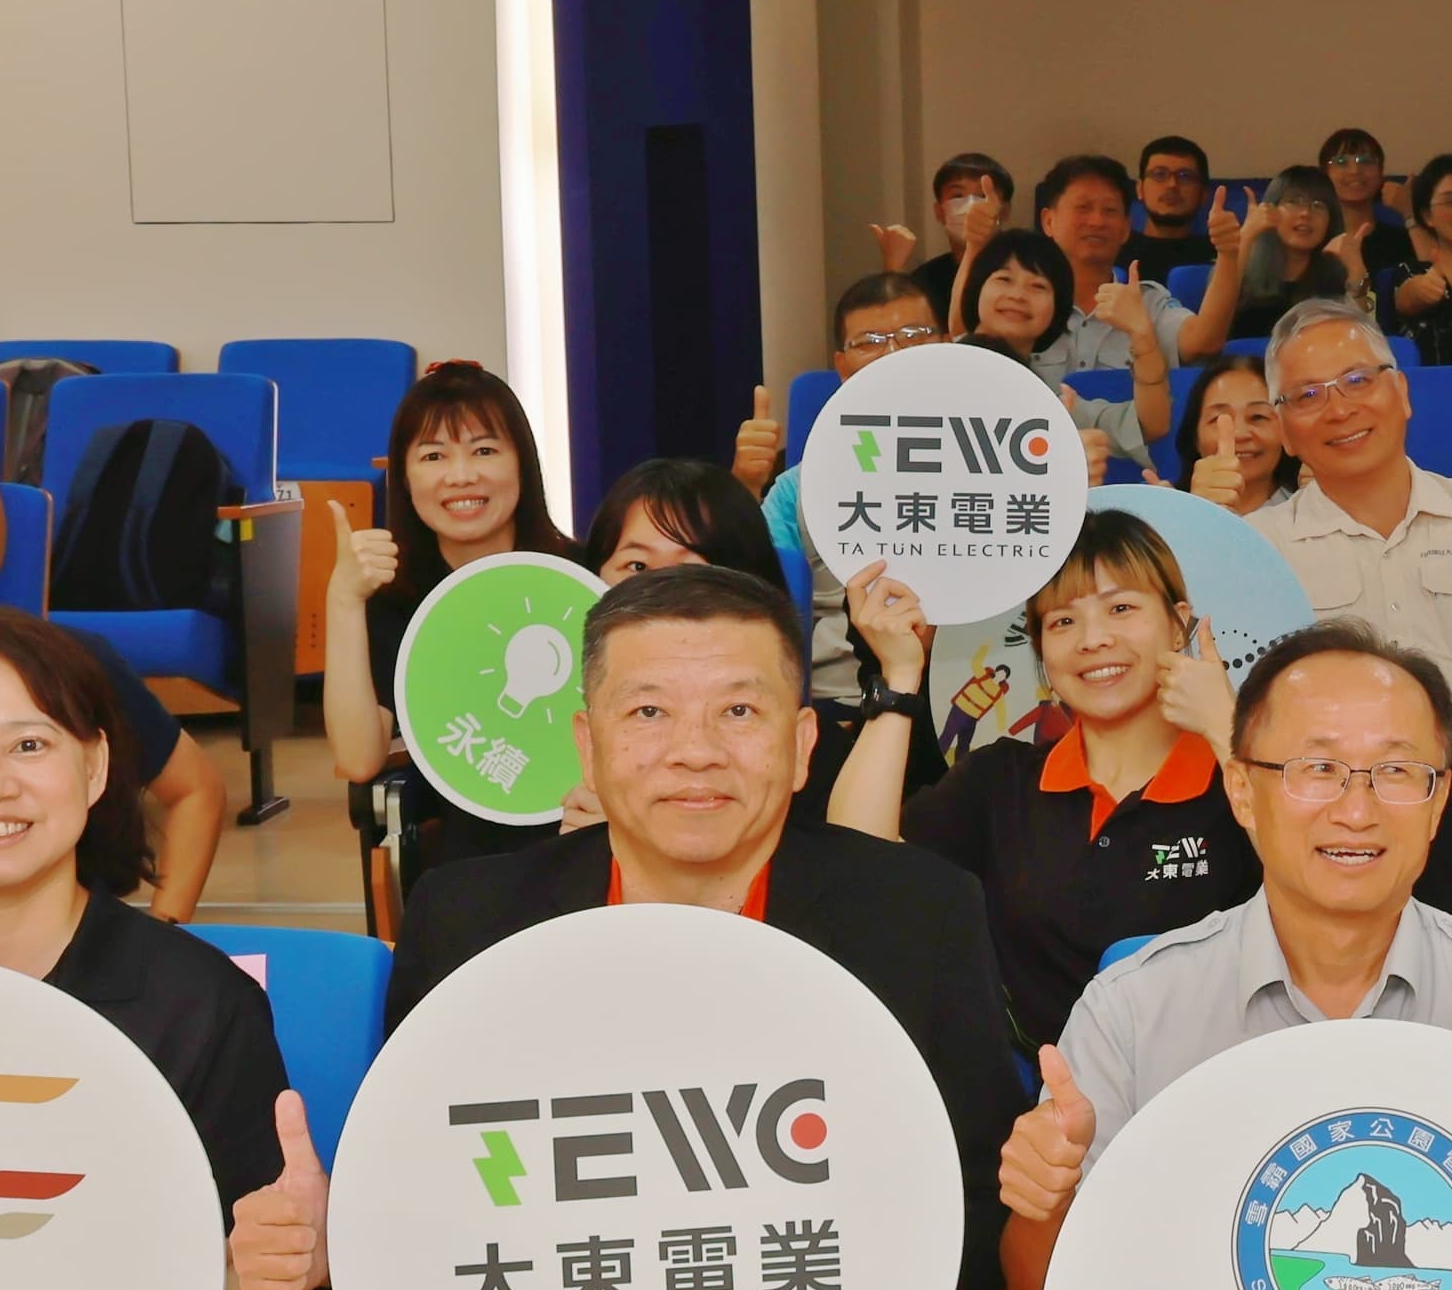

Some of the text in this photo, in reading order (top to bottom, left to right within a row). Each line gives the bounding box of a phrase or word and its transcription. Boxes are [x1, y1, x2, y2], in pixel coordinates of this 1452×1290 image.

[838, 490, 1050, 535] 大東電業
[839, 542, 864, 556] TA
[436, 712, 531, 796] 永續
[1151, 837, 1208, 865] TEW
[1144, 859, 1209, 881] 大東電業
